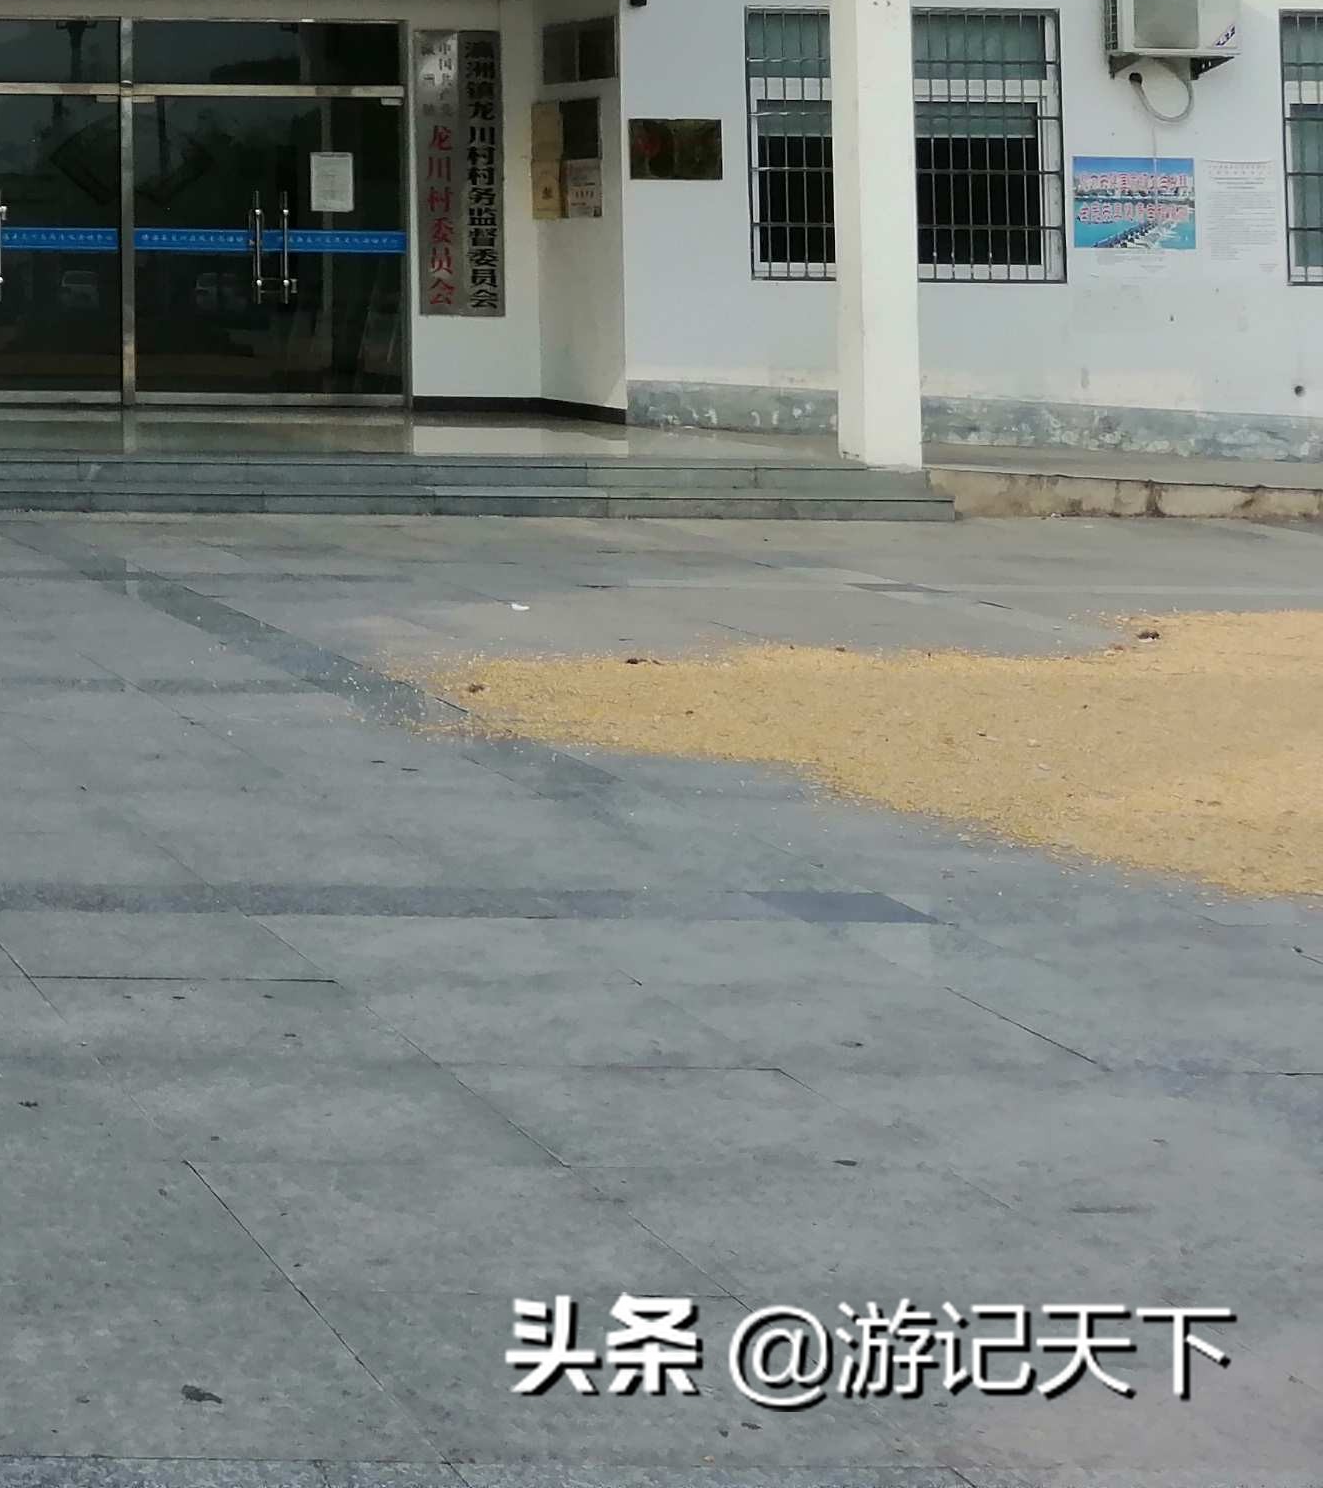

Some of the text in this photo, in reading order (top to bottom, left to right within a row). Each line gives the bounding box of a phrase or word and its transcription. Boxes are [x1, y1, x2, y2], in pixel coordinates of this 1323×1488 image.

[427, 125, 455, 306] 龙川村委员会
